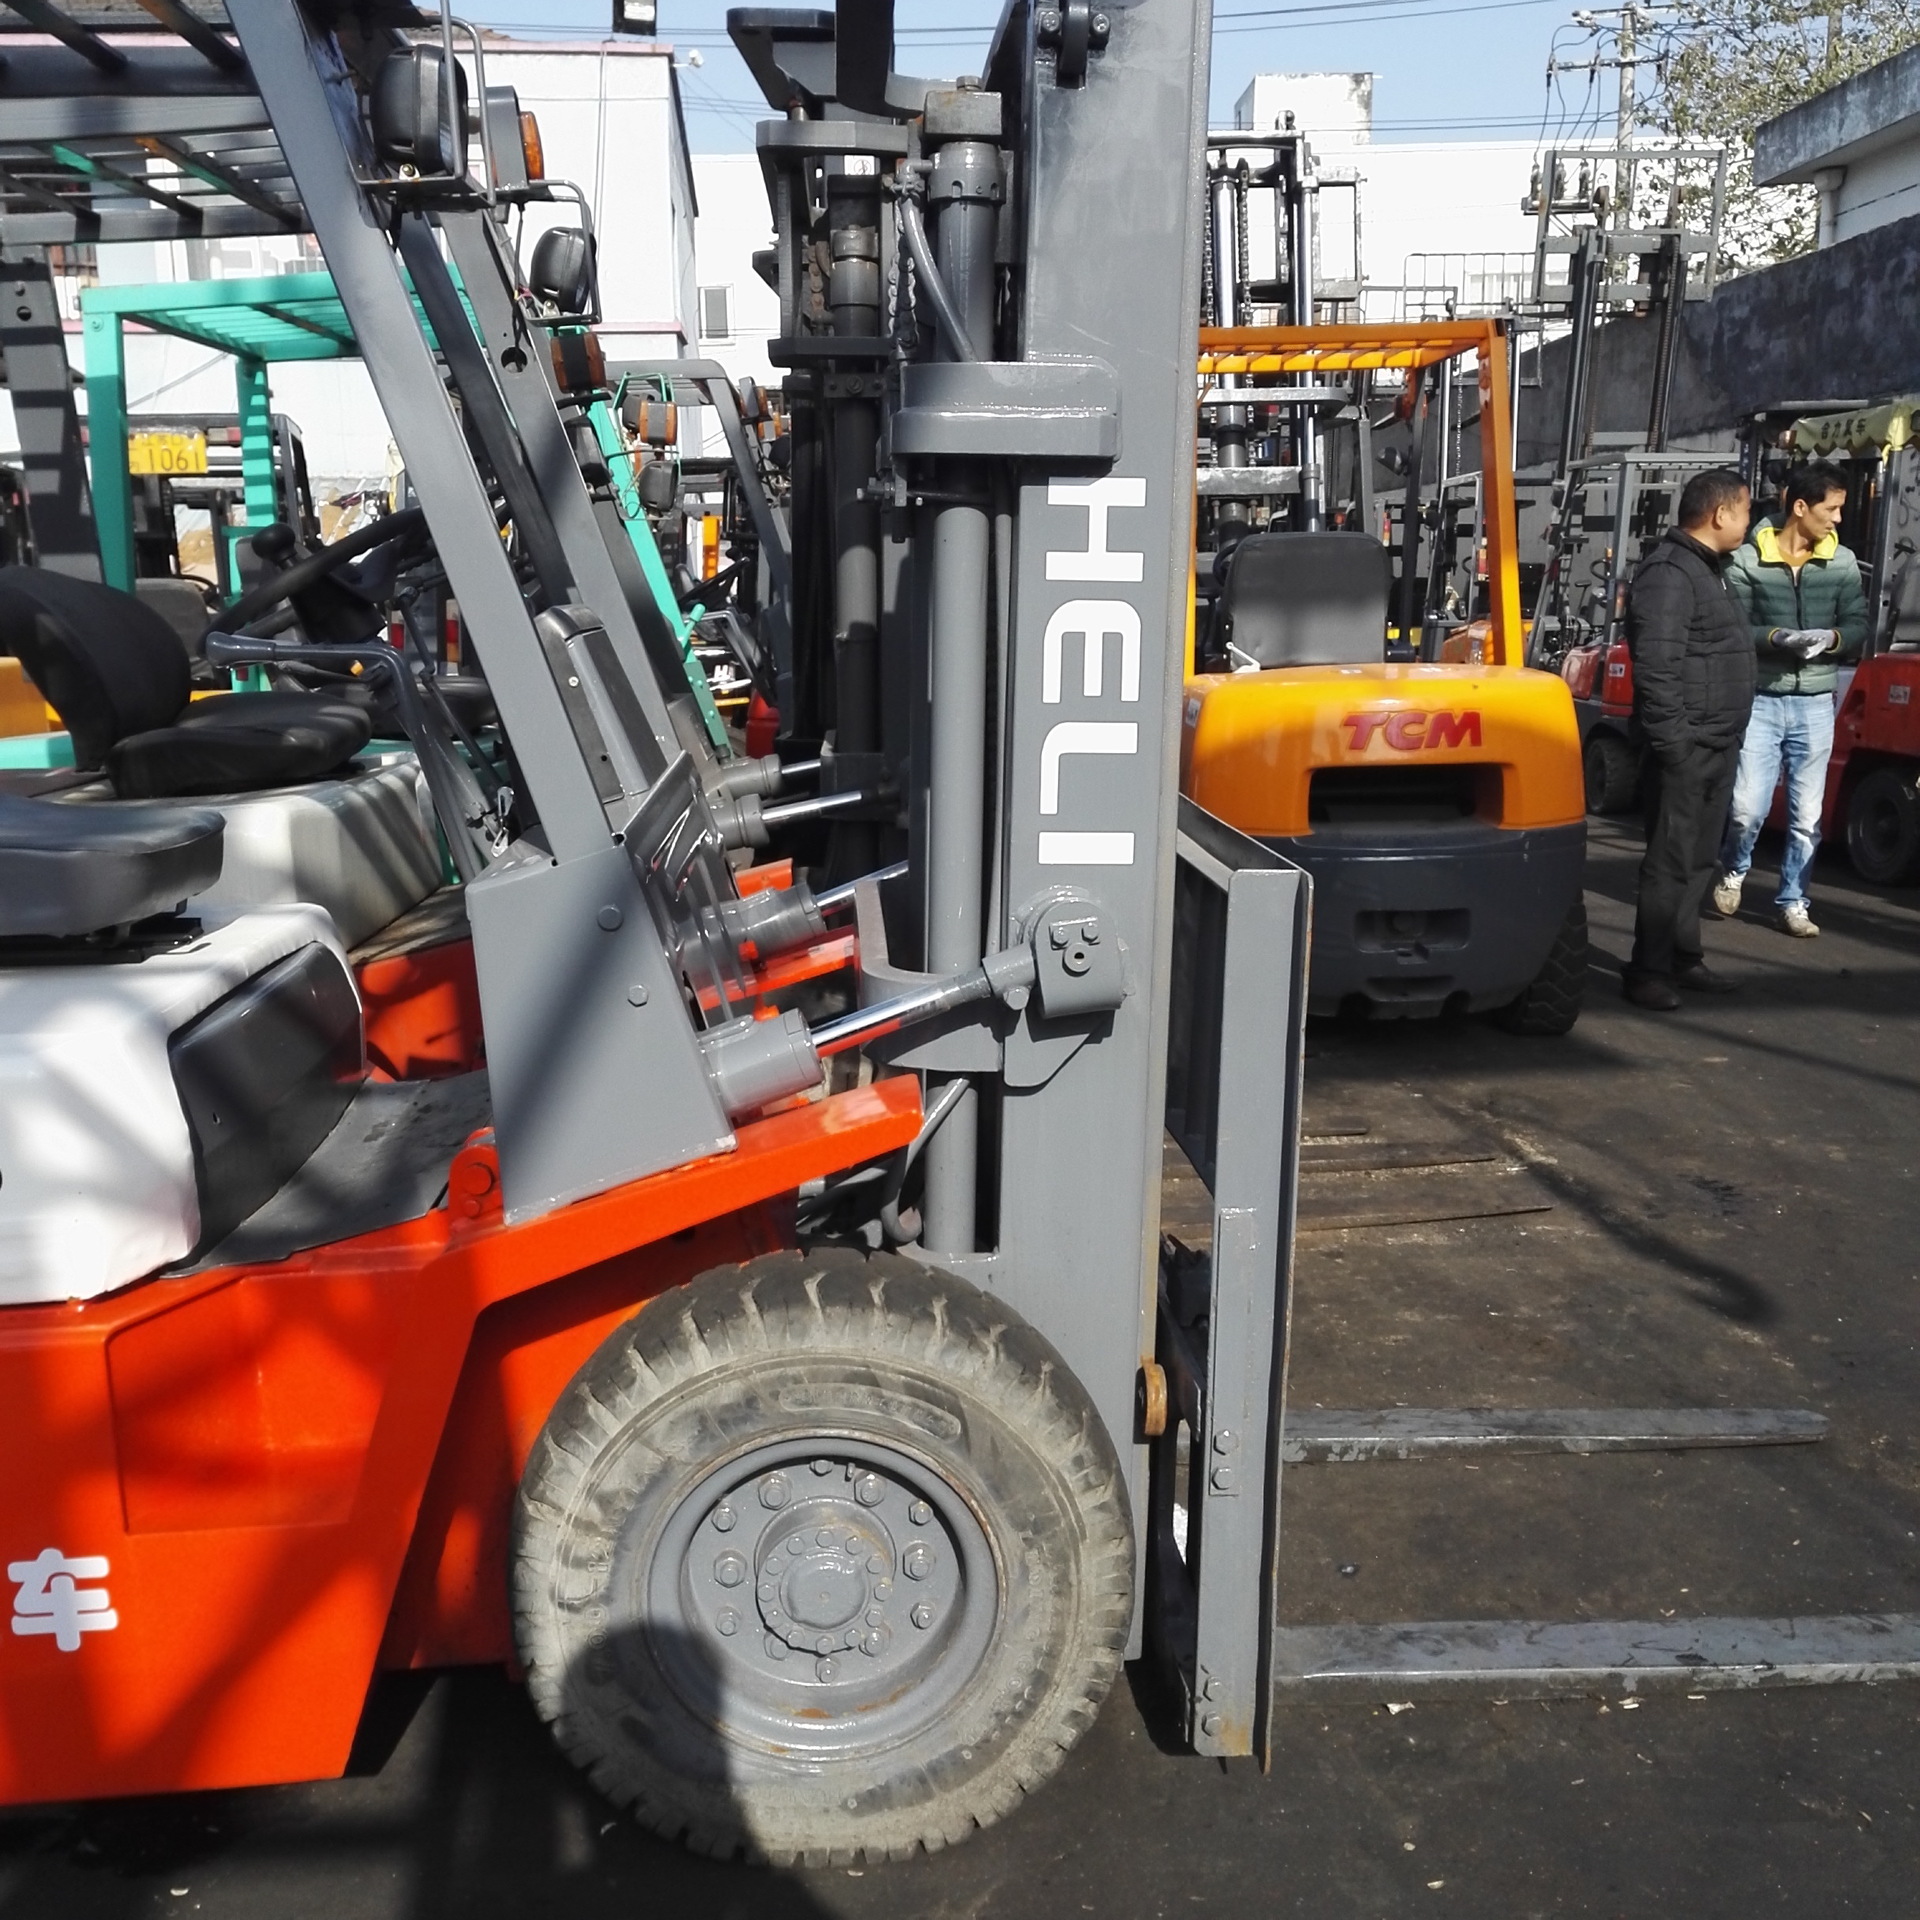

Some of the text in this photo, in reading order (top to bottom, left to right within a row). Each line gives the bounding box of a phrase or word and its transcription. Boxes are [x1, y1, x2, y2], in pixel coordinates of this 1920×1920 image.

[149, 447, 199, 472] 1061
[1038, 476, 1147, 865] HELI
[1341, 710, 1483, 751] TCM
[7, 1547, 119, 1652] 车
